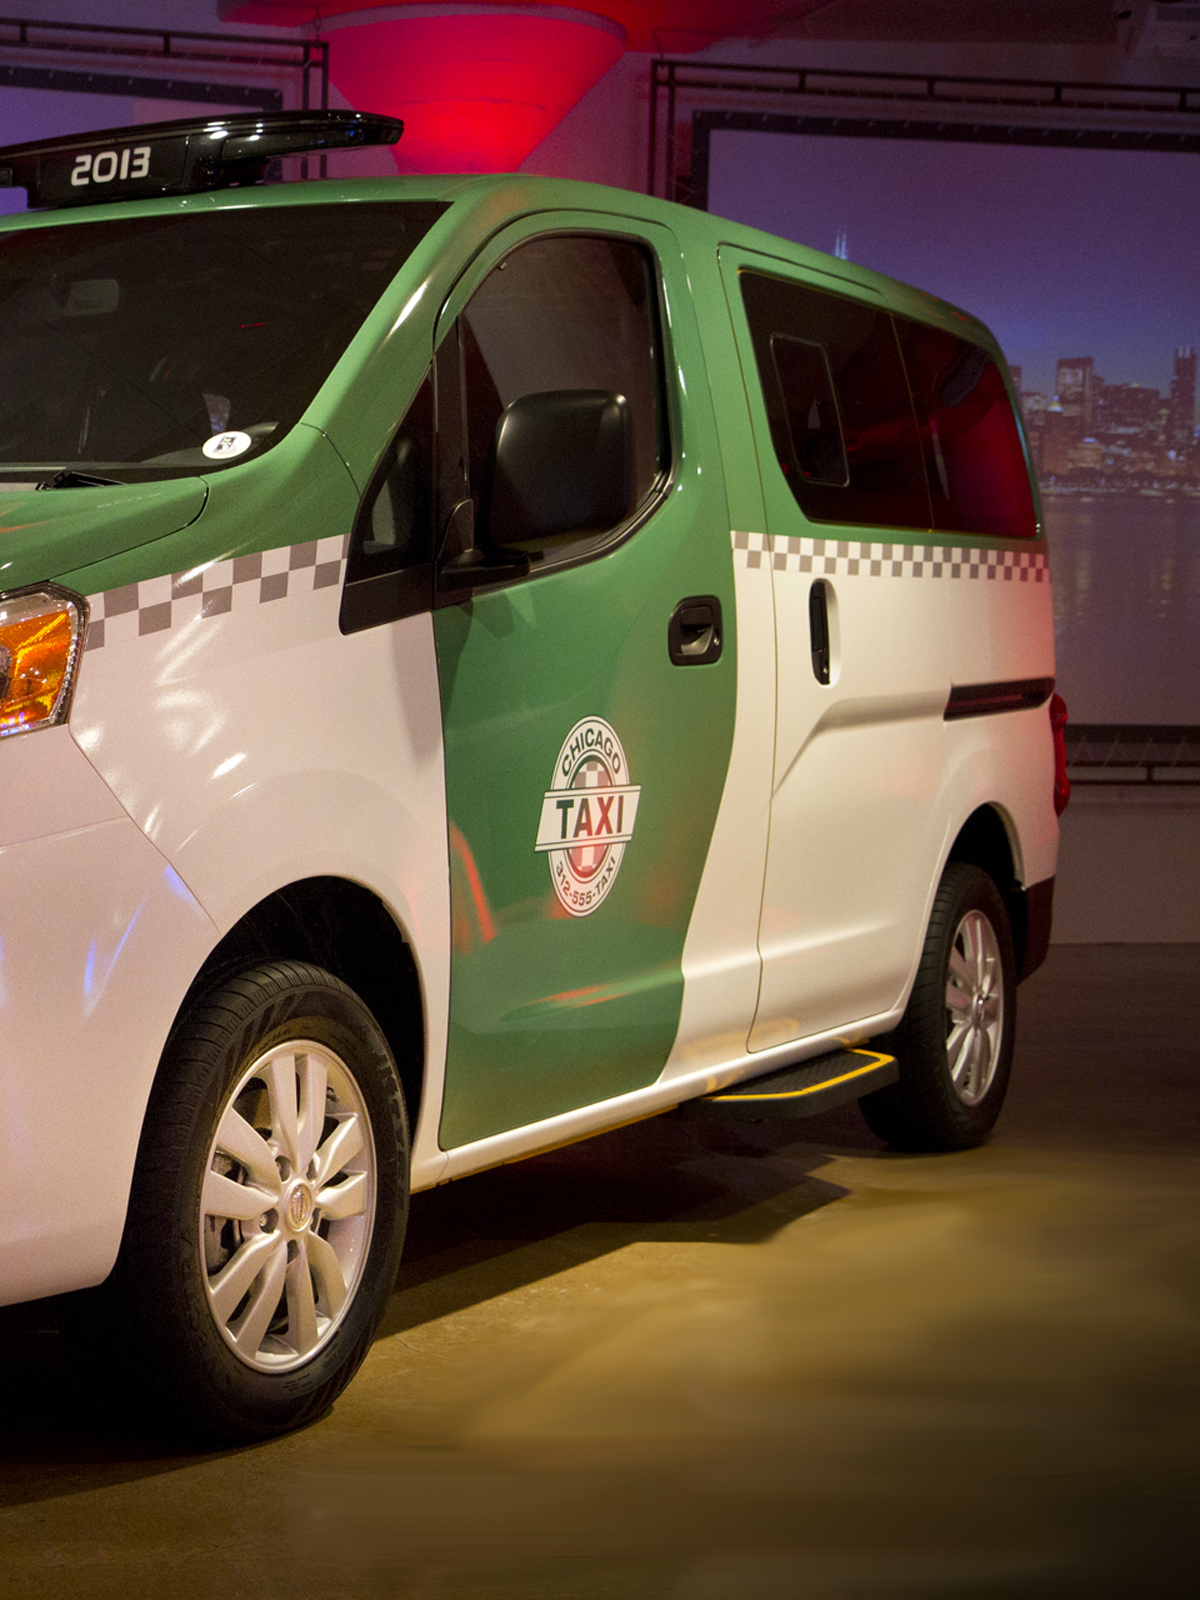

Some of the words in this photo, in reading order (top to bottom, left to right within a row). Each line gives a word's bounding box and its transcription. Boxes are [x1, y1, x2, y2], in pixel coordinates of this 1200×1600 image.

[70, 146, 151, 186] 2013
[561, 728, 621, 777] CHICAGO
[555, 795, 625, 840] TAXI
[555, 856, 616, 906] 312-555-TAXI
